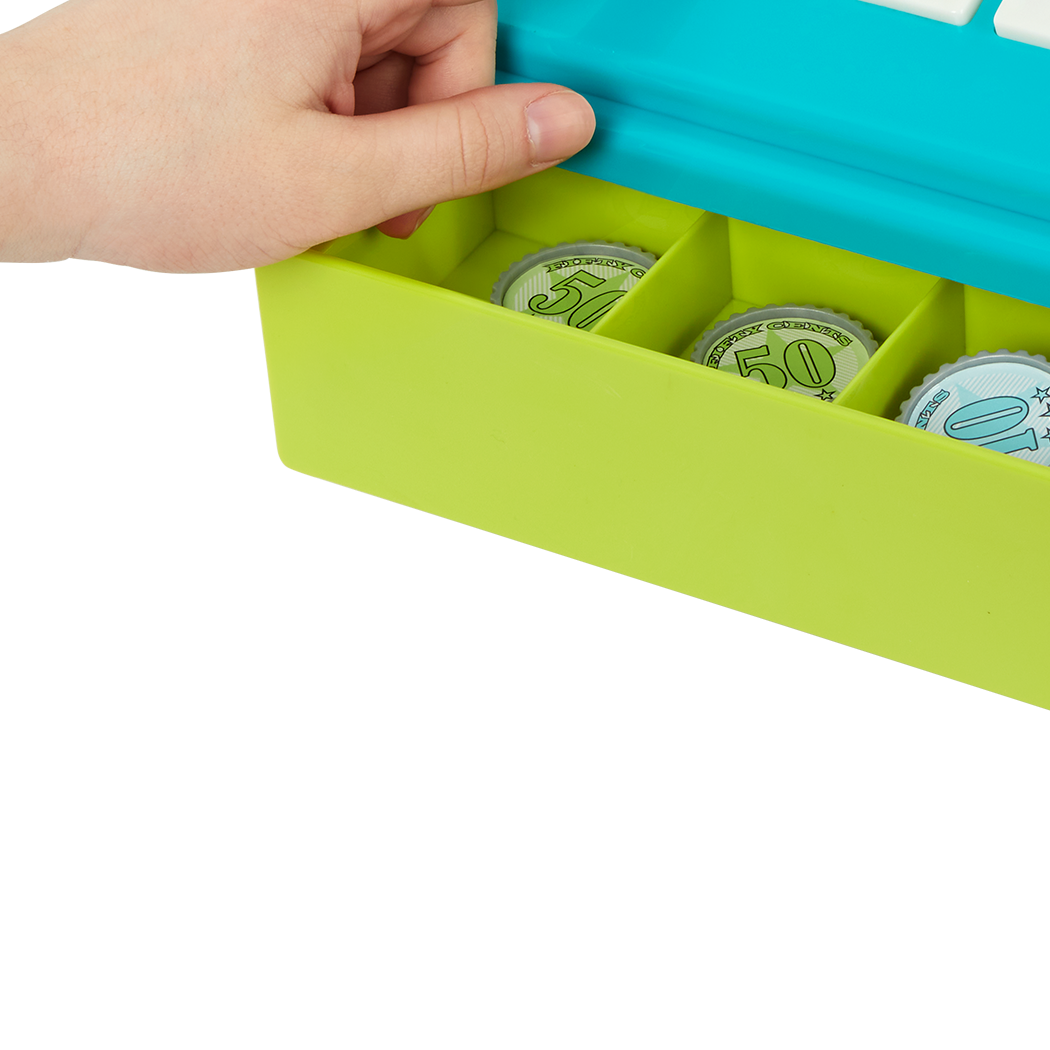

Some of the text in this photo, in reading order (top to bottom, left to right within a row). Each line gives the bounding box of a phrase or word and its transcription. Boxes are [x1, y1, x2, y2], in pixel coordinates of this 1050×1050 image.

[543, 257, 634, 273] FIFTY
[706, 320, 853, 370] FIFTY CENTS
[733, 338, 837, 390] 50
[915, 388, 951, 431] NTS
